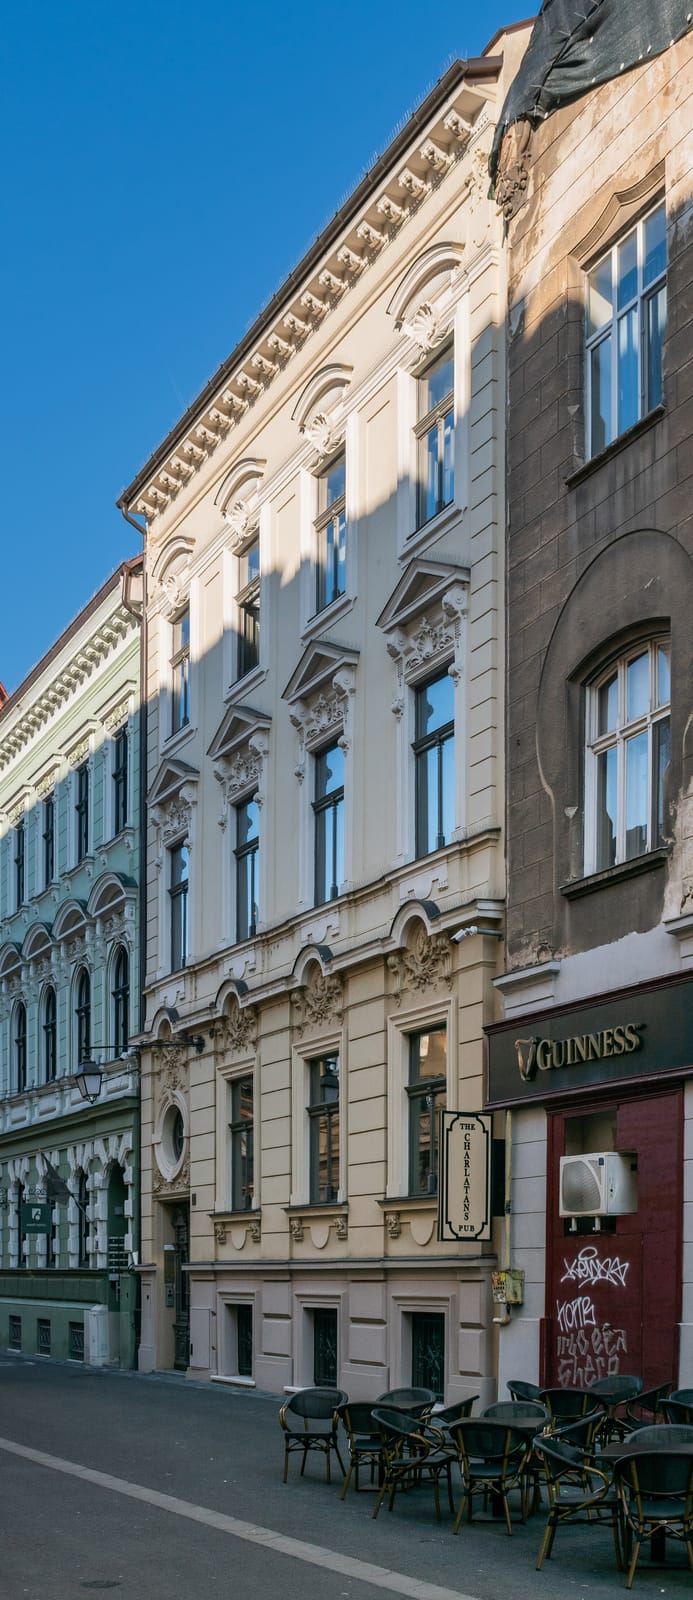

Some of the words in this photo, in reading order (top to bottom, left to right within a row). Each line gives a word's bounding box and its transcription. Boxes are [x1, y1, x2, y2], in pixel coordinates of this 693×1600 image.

[536, 1023, 641, 1071] GUINNESS
[459, 1123, 476, 1131] THE
[463, 1133, 471, 1221] CHARLATANS
